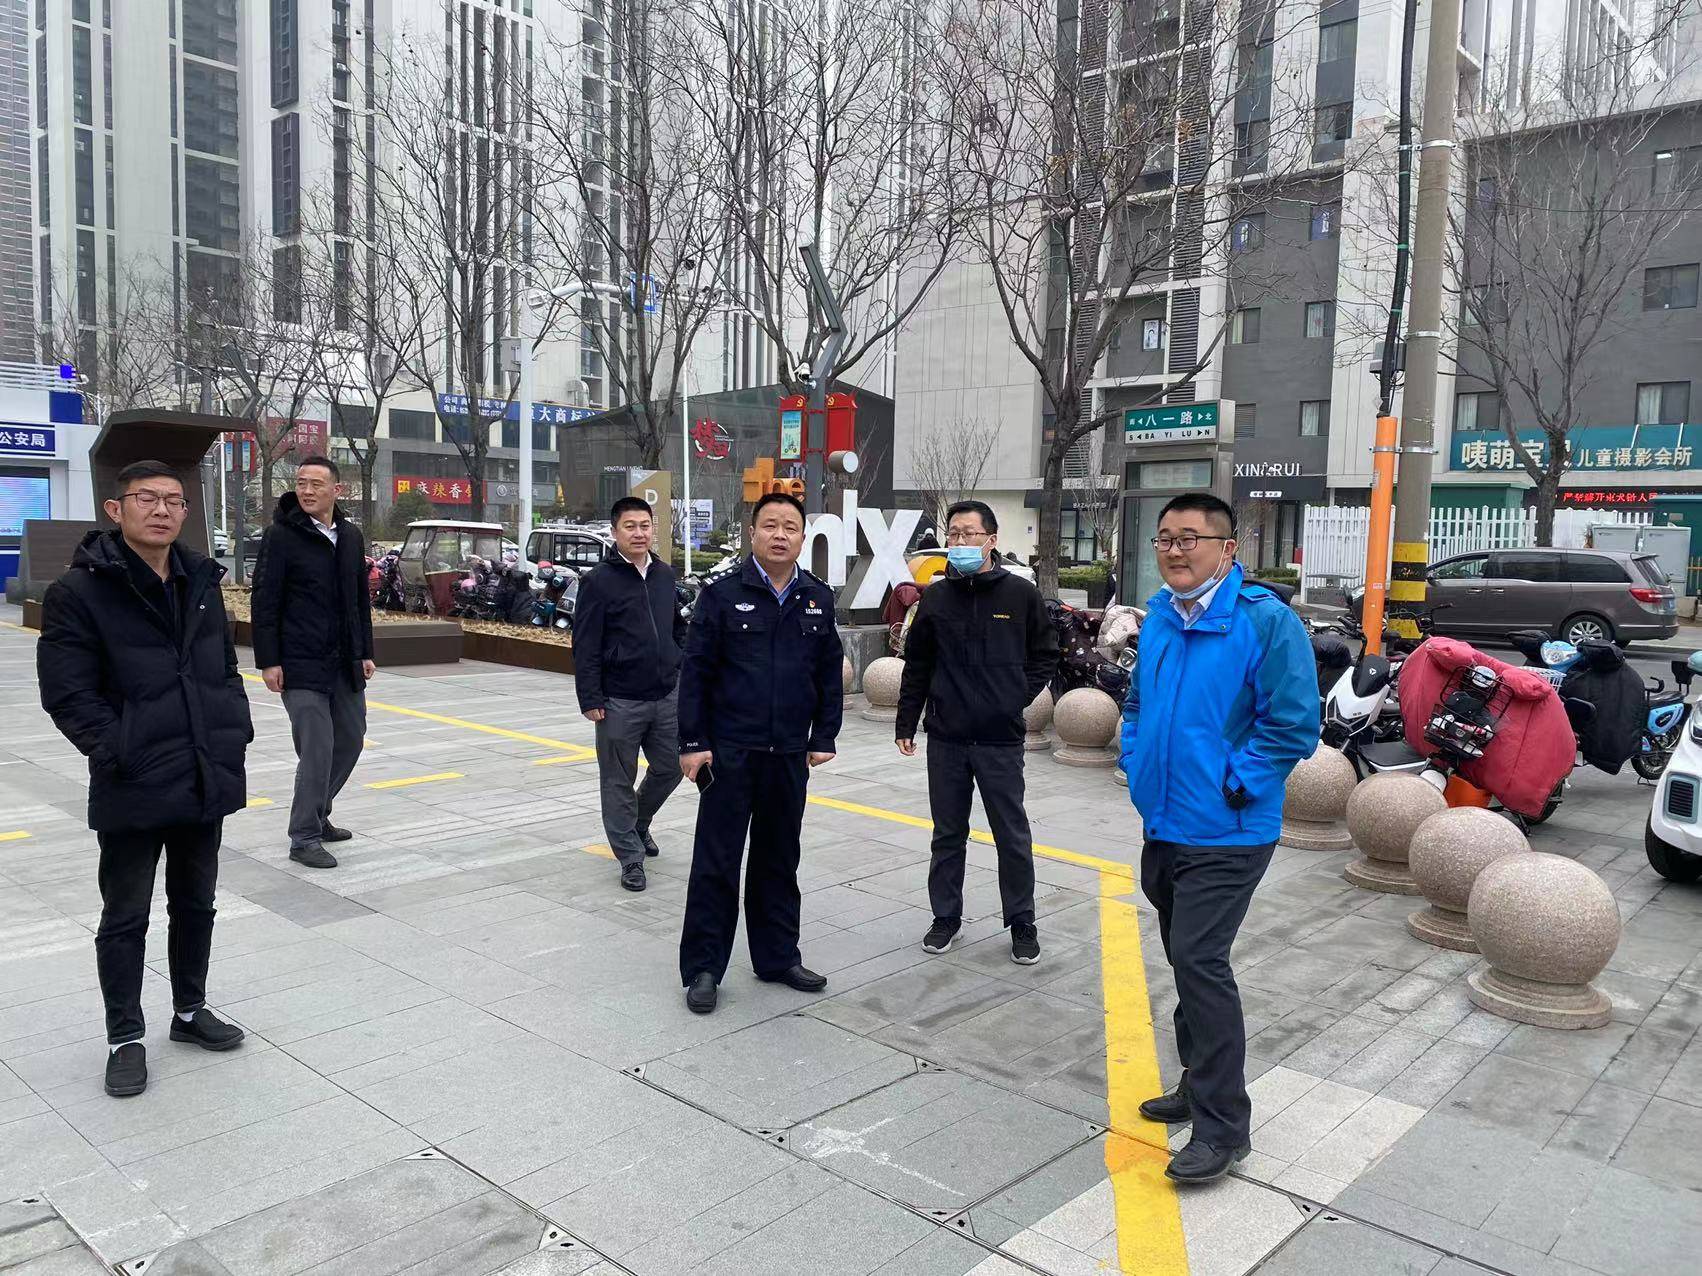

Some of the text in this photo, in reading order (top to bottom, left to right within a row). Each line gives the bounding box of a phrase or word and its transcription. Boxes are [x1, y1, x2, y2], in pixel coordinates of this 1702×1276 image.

[1145, 410, 1193, 427] 八一路
[1205, 412, 1212, 421] 北
[0, 431, 46, 447] 公安局
[1144, 432, 1155, 440] BA
[1164, 431, 1173, 439] YI
[1181, 429, 1192, 437] LU
[1204, 428, 1210, 436] N
[1577, 442, 1692, 467] 儿童摄影会所
